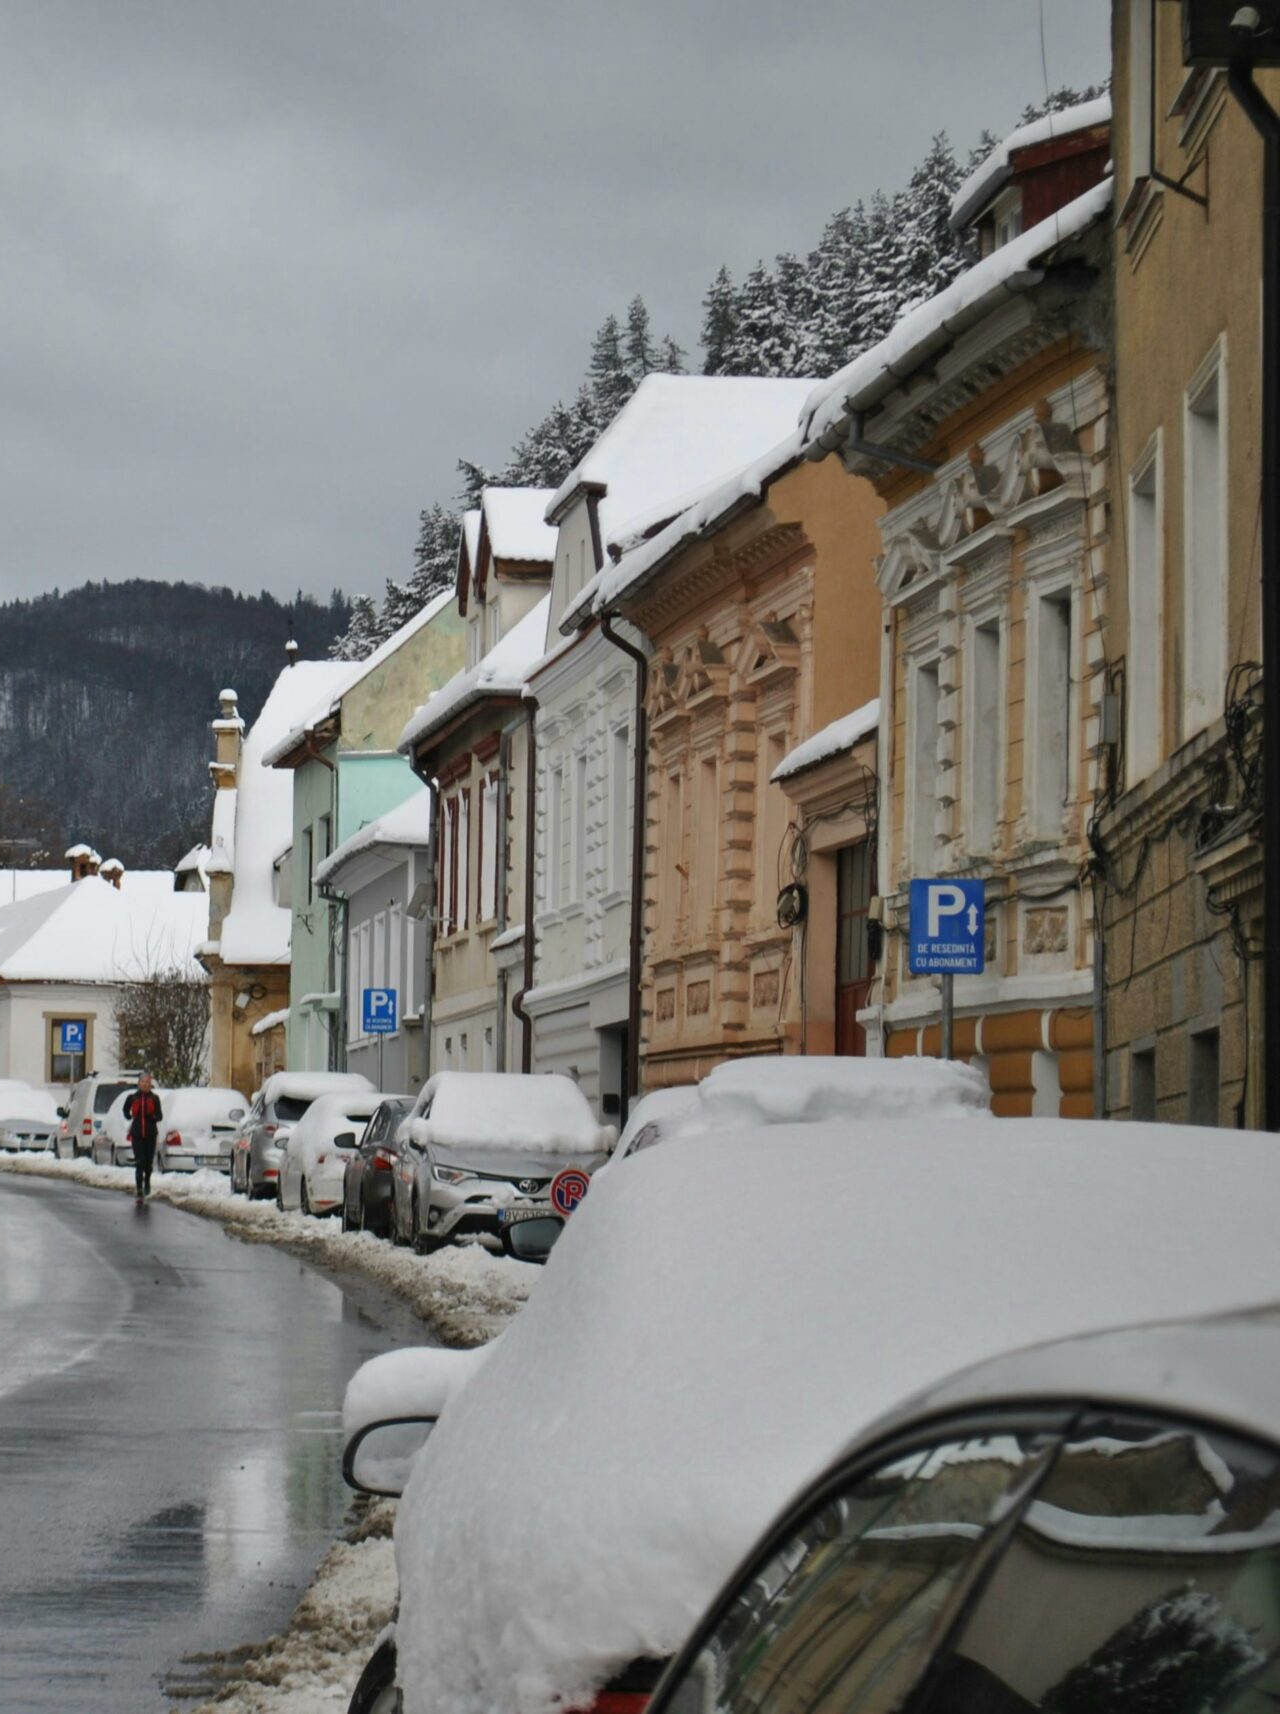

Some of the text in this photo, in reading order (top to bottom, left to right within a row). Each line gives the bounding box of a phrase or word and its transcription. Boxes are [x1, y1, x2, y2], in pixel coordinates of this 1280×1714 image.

[928, 885, 966, 937] P
[918, 943, 928, 954] DE
[915, 957, 977, 968] CU ABONAMENT
[371, 991, 388, 1016] P
[66, 1024, 78, 1041] P
